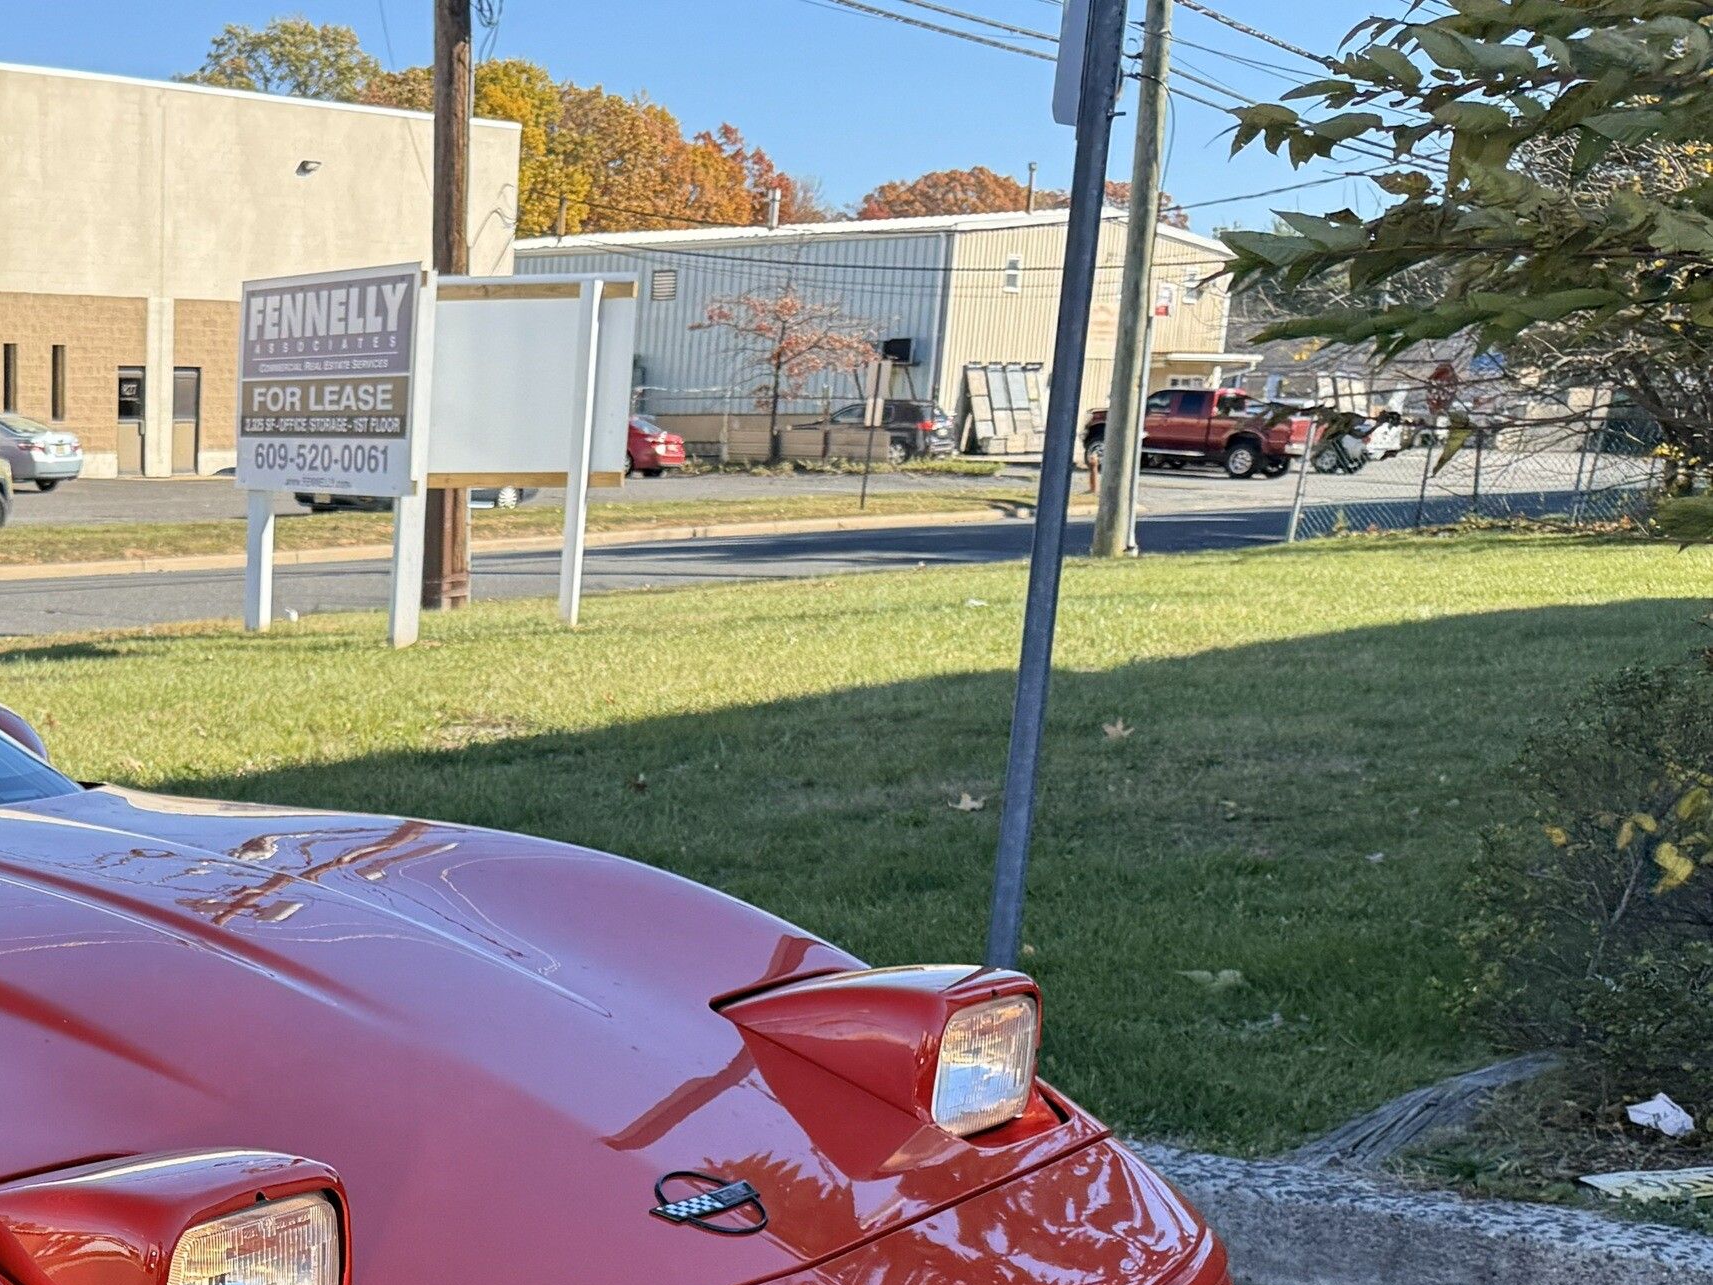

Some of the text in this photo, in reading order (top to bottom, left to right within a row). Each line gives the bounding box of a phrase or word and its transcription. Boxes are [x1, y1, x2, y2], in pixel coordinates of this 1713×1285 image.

[248, 283, 408, 341] FENNELLY
[254, 336, 397, 354] ASSOCIATES
[252, 384, 393, 412] FOR LEASE
[370, 417, 400, 433] FLOOR
[254, 442, 389, 474] 609-520-0061
